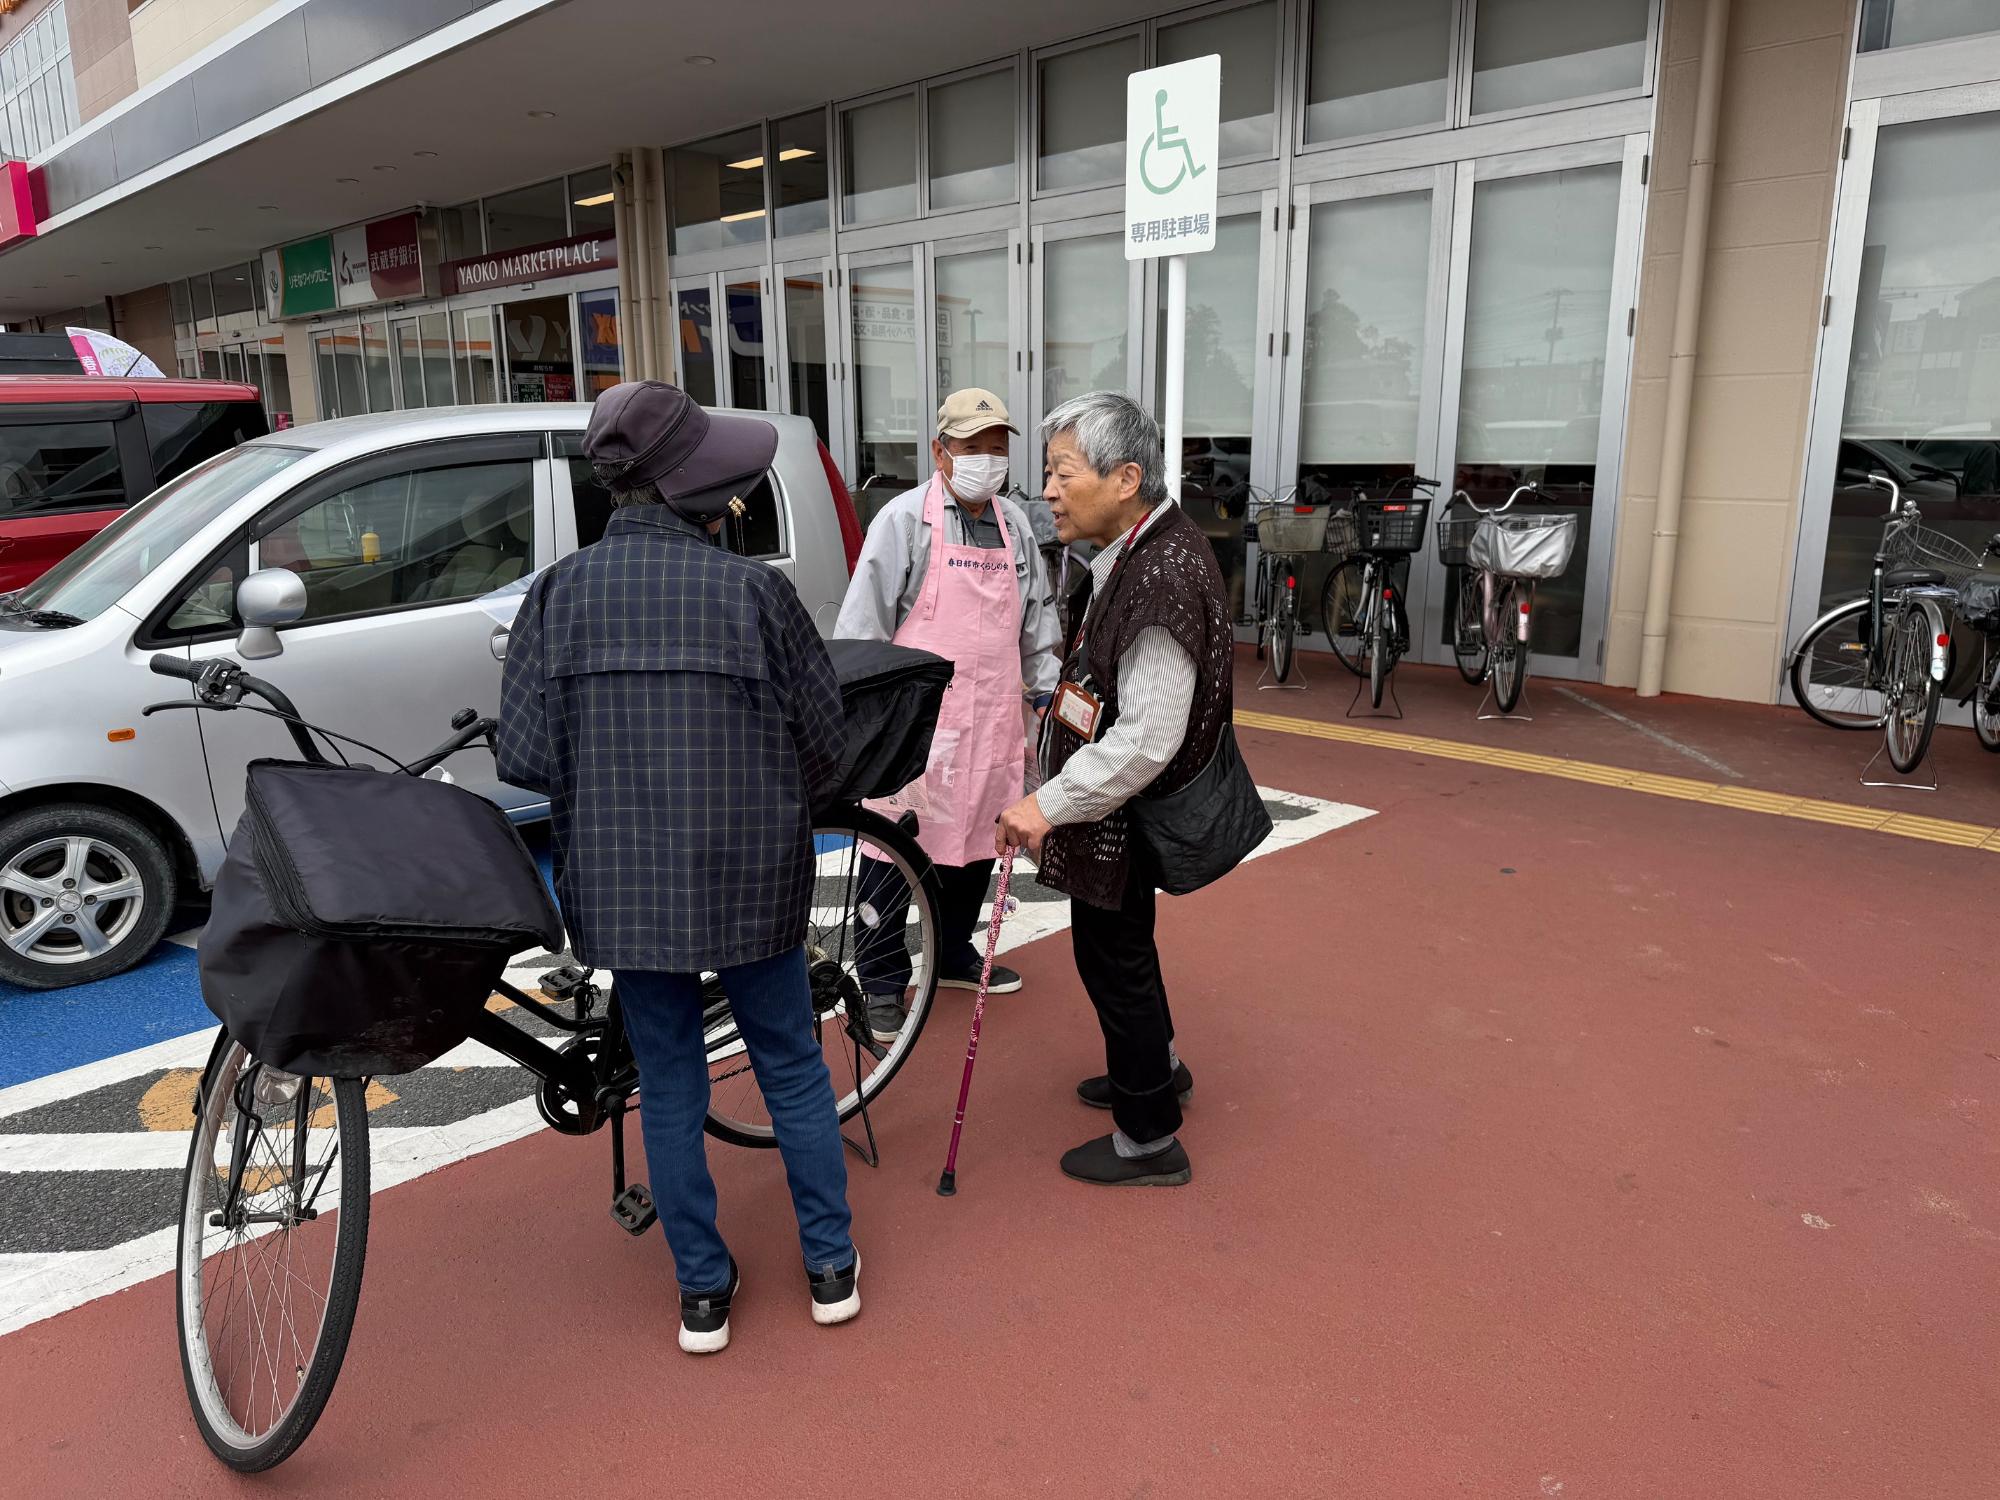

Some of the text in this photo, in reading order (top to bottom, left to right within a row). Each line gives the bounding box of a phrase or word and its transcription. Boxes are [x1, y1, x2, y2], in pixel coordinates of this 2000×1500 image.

[1131, 213, 1210, 243] 専用駐車場
[369, 243, 418, 273] 武蔵野銀行
[458, 239, 601, 286] YAOKO MARKETPLACE
[948, 557, 1009, 571] 春日部市くらしの会
